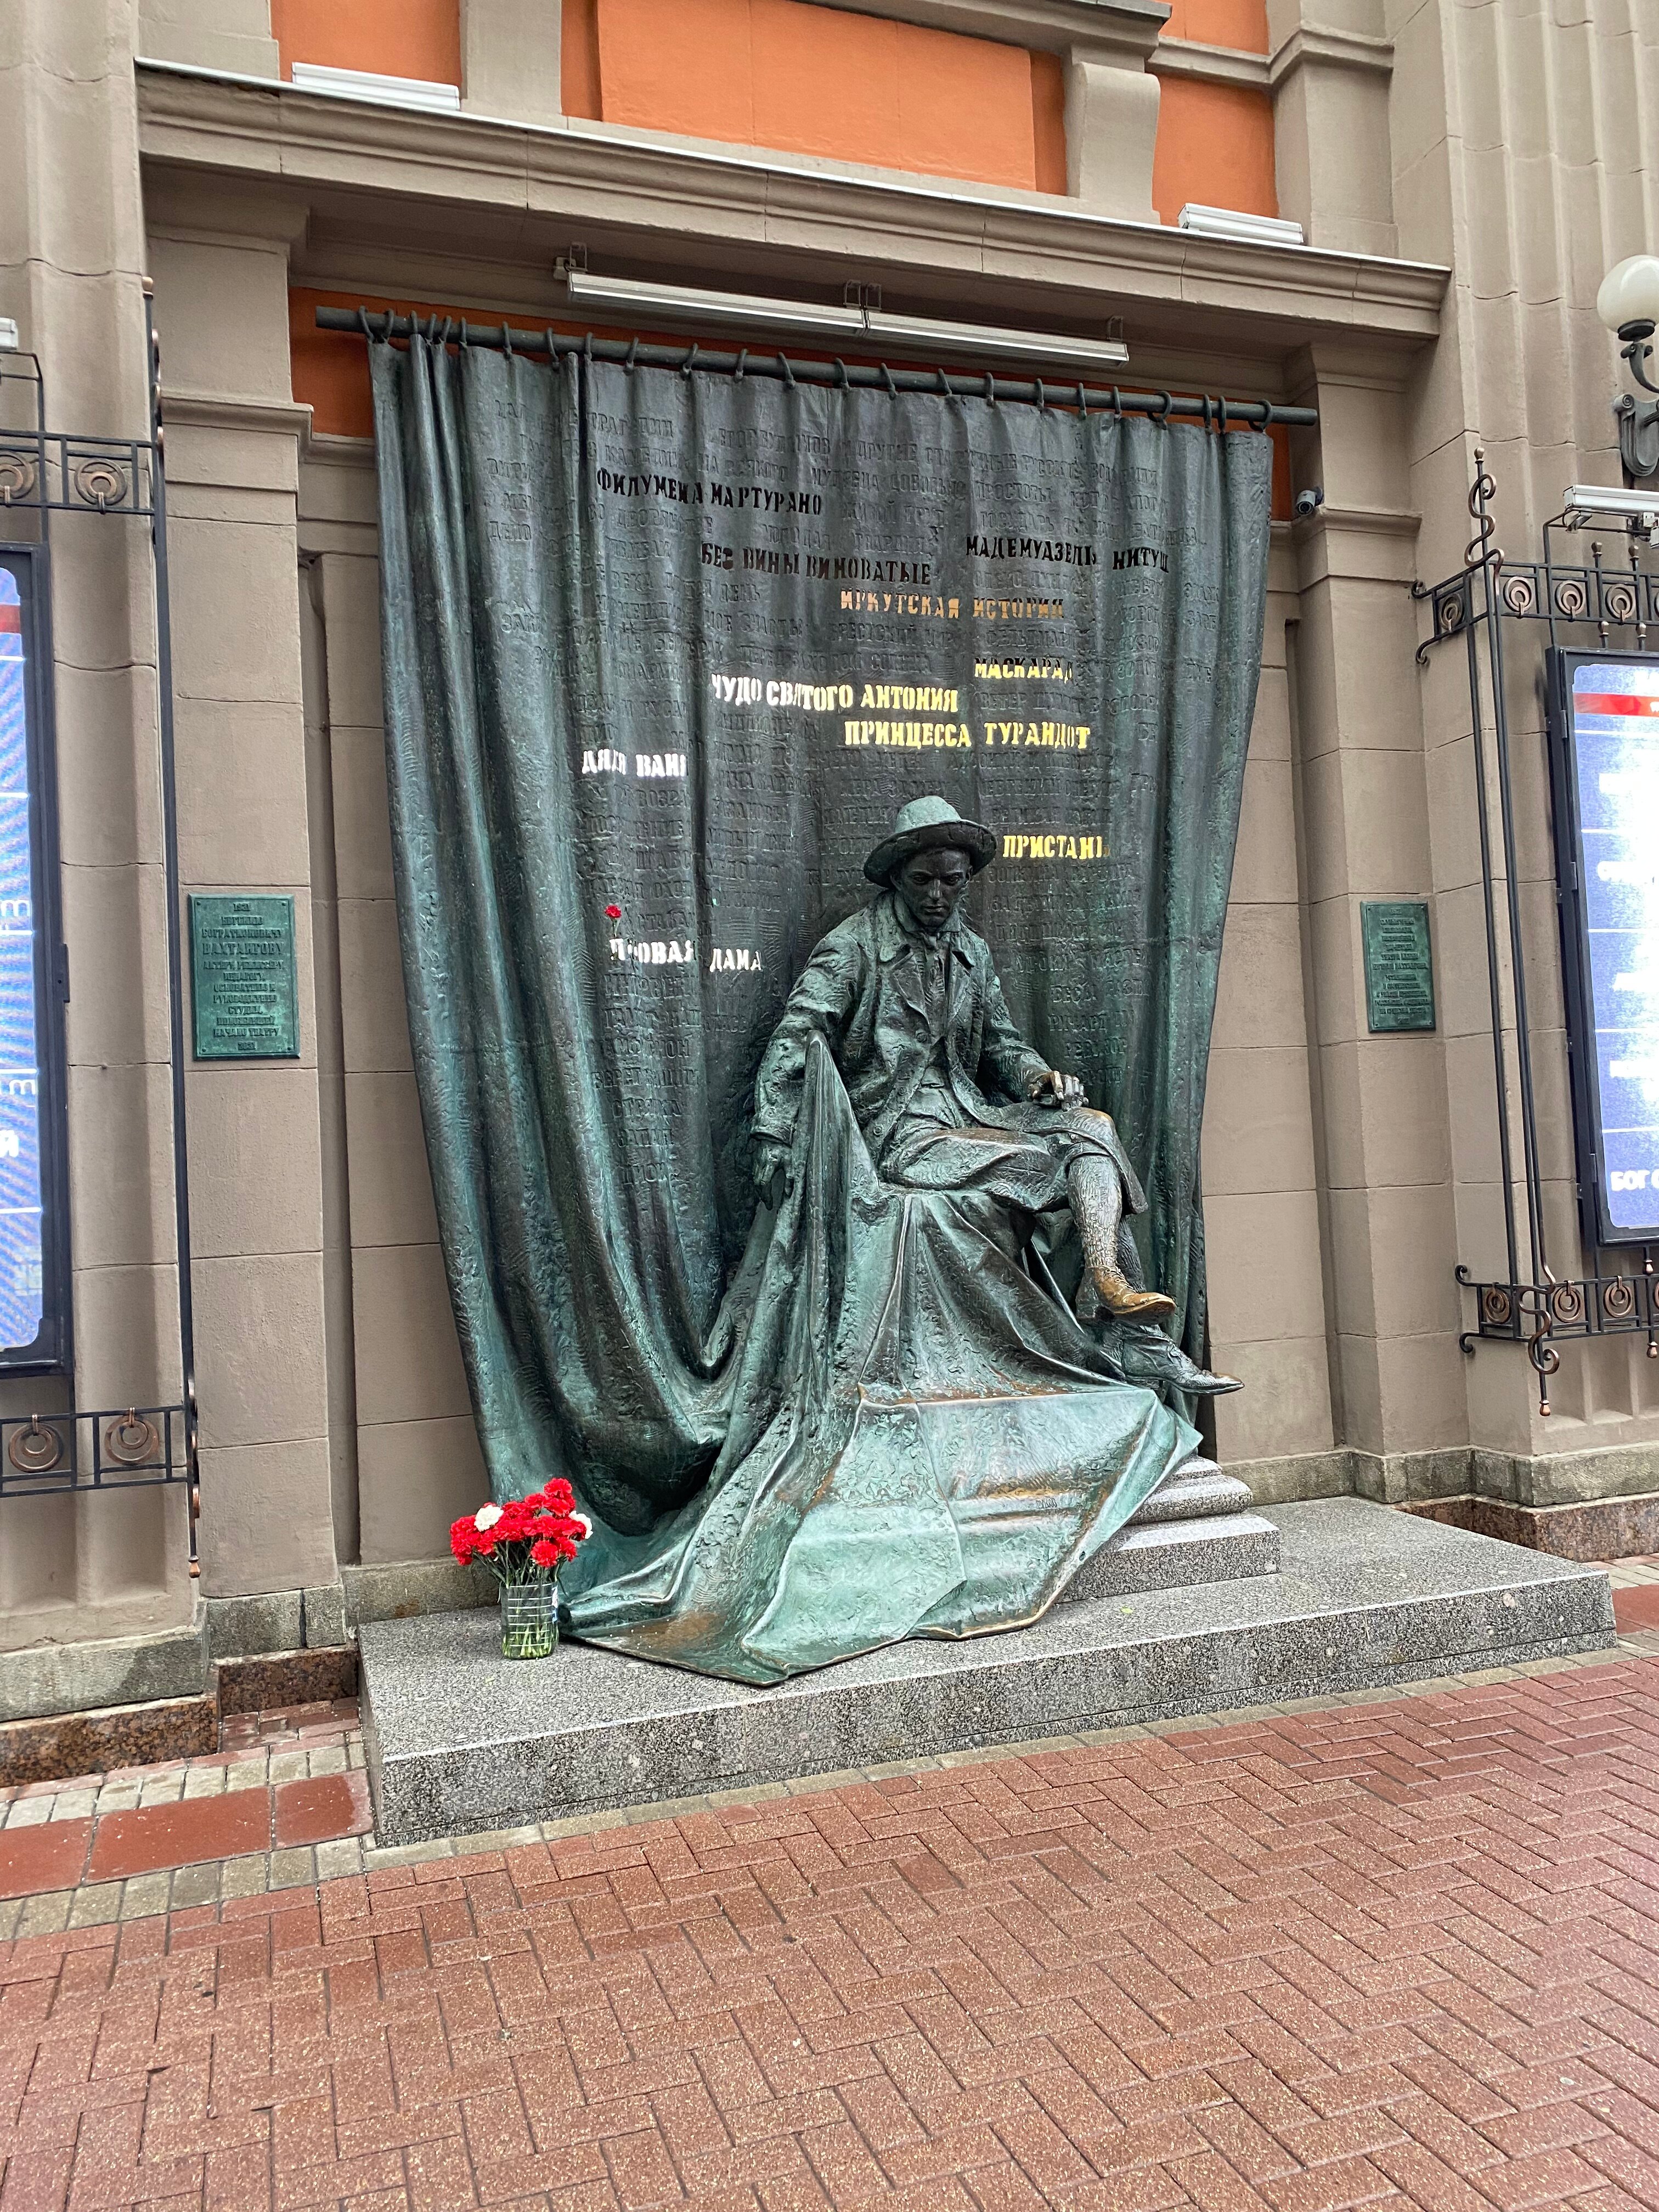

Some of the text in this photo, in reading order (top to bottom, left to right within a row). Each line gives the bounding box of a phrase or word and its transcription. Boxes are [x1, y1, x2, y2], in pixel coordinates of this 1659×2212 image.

[597, 467, 822, 516] ФИЛУМЕНА МАРТУРАНО
[743, 546, 799, 574] ВИНЫ
[805, 554, 931, 585] ВИНОВАТЫЕ
[966, 536, 1169, 573] МАДЕМУАЗЕЛЬ НИТУШ
[840, 588, 1064, 620] ИРКУТСКАЯ ИСТОРИЯ
[975, 657, 1073, 684] МАСКАРАД
[712, 673, 958, 713] ЧУДО СВЯТОГО АНТОНИЯ
[844, 721, 972, 749] ПРИНЦЕССА
[984, 721, 1091, 749] ТУРАНДОТ
[582, 748, 626, 775] ДЯДЯ
[710, 949, 761, 972] ДАМА
